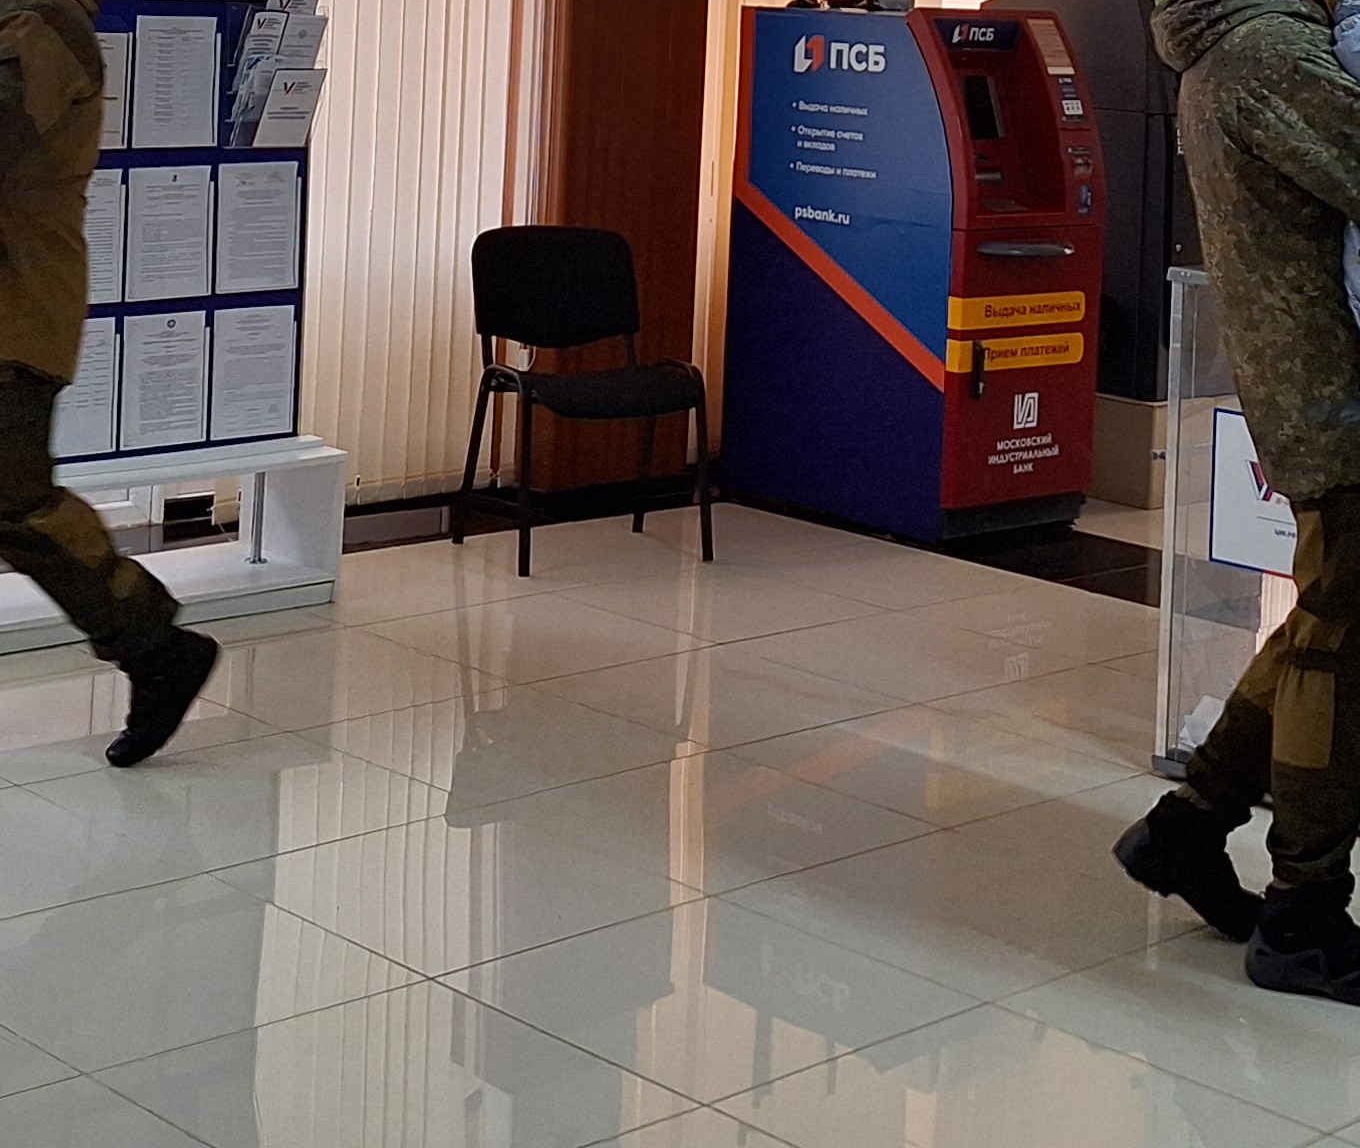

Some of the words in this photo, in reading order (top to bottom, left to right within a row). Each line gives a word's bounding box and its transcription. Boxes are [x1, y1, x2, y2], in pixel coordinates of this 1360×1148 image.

[968, 25, 995, 42] ПСБ
[829, 41, 887, 73] ПСБ
[797, 124, 835, 138] Открытие
[794, 204, 851, 226] psbank.ru
[984, 305, 1027, 319] Выдача
[1029, 301, 1082, 314] наличных
[1020, 340, 1070, 357] платежей
[996, 432, 1052, 451] МОСКОВСКИЙ
[987, 444, 1060, 465] ИНДУСТРИАЛЬНЫЙ
